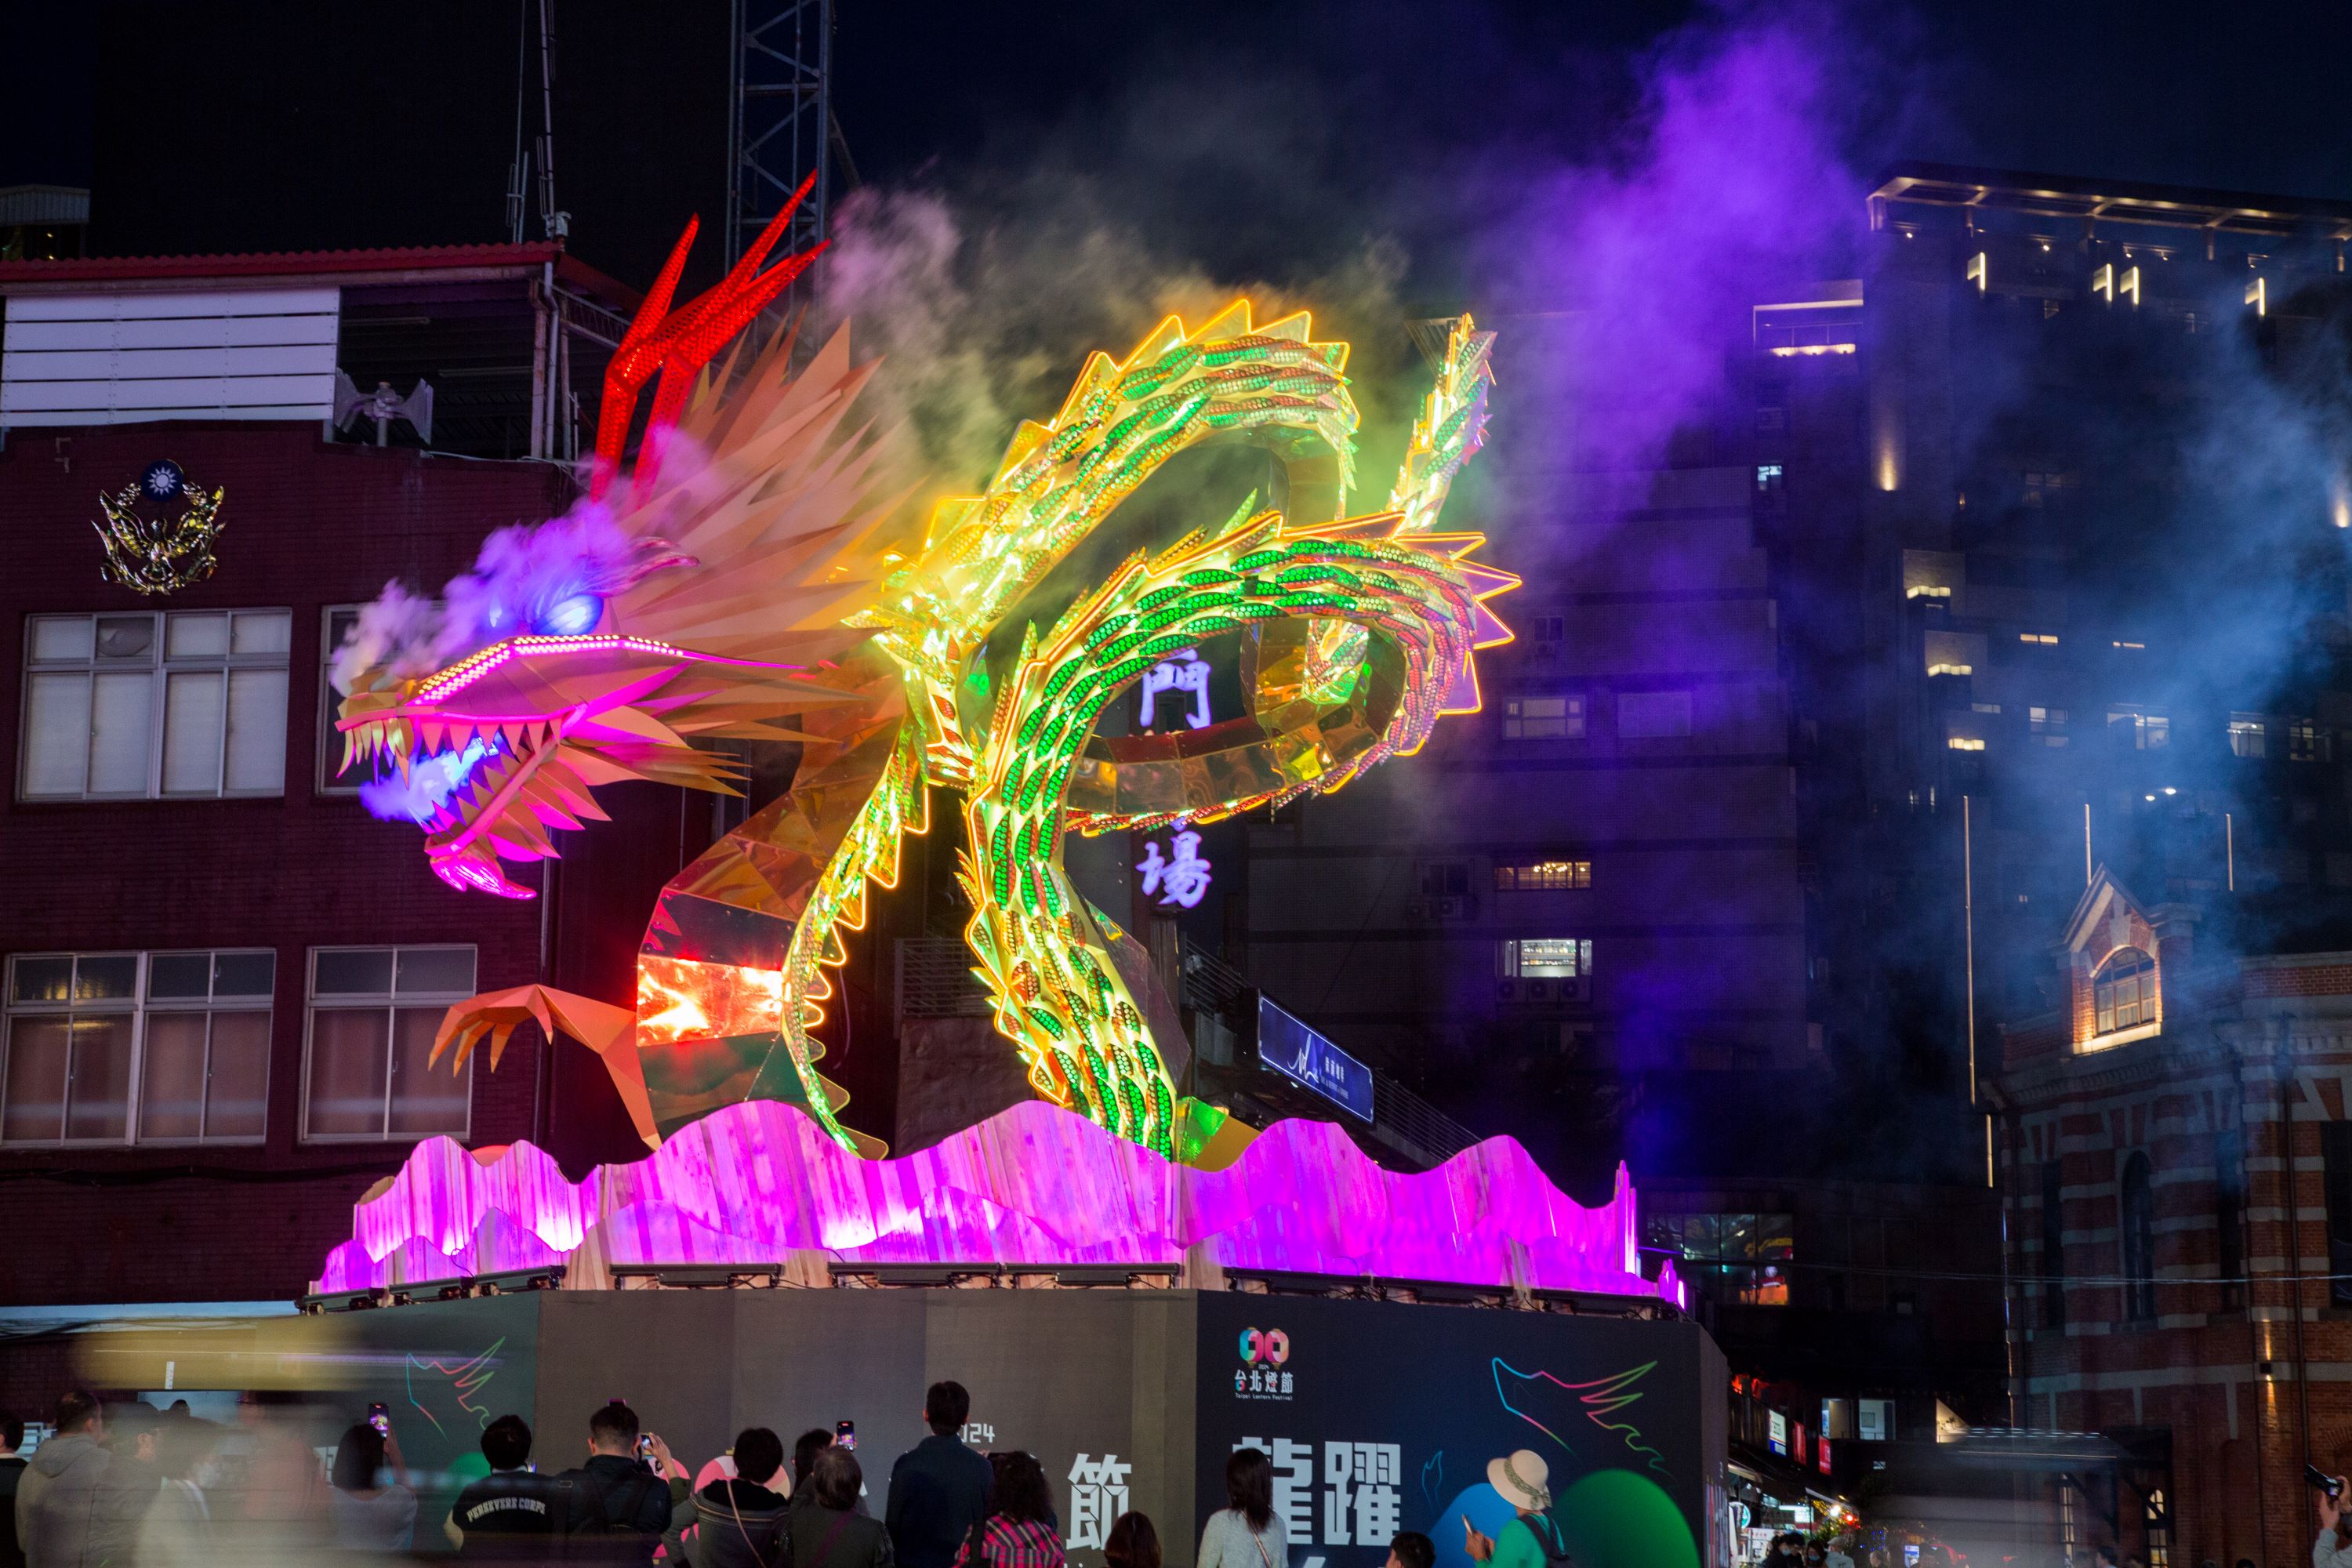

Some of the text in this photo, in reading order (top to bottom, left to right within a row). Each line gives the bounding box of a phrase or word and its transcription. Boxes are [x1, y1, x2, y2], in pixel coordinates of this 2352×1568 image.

[1234, 1369, 1294, 1393] 台北燈節
[517, 1497, 546, 1515] CORPS
